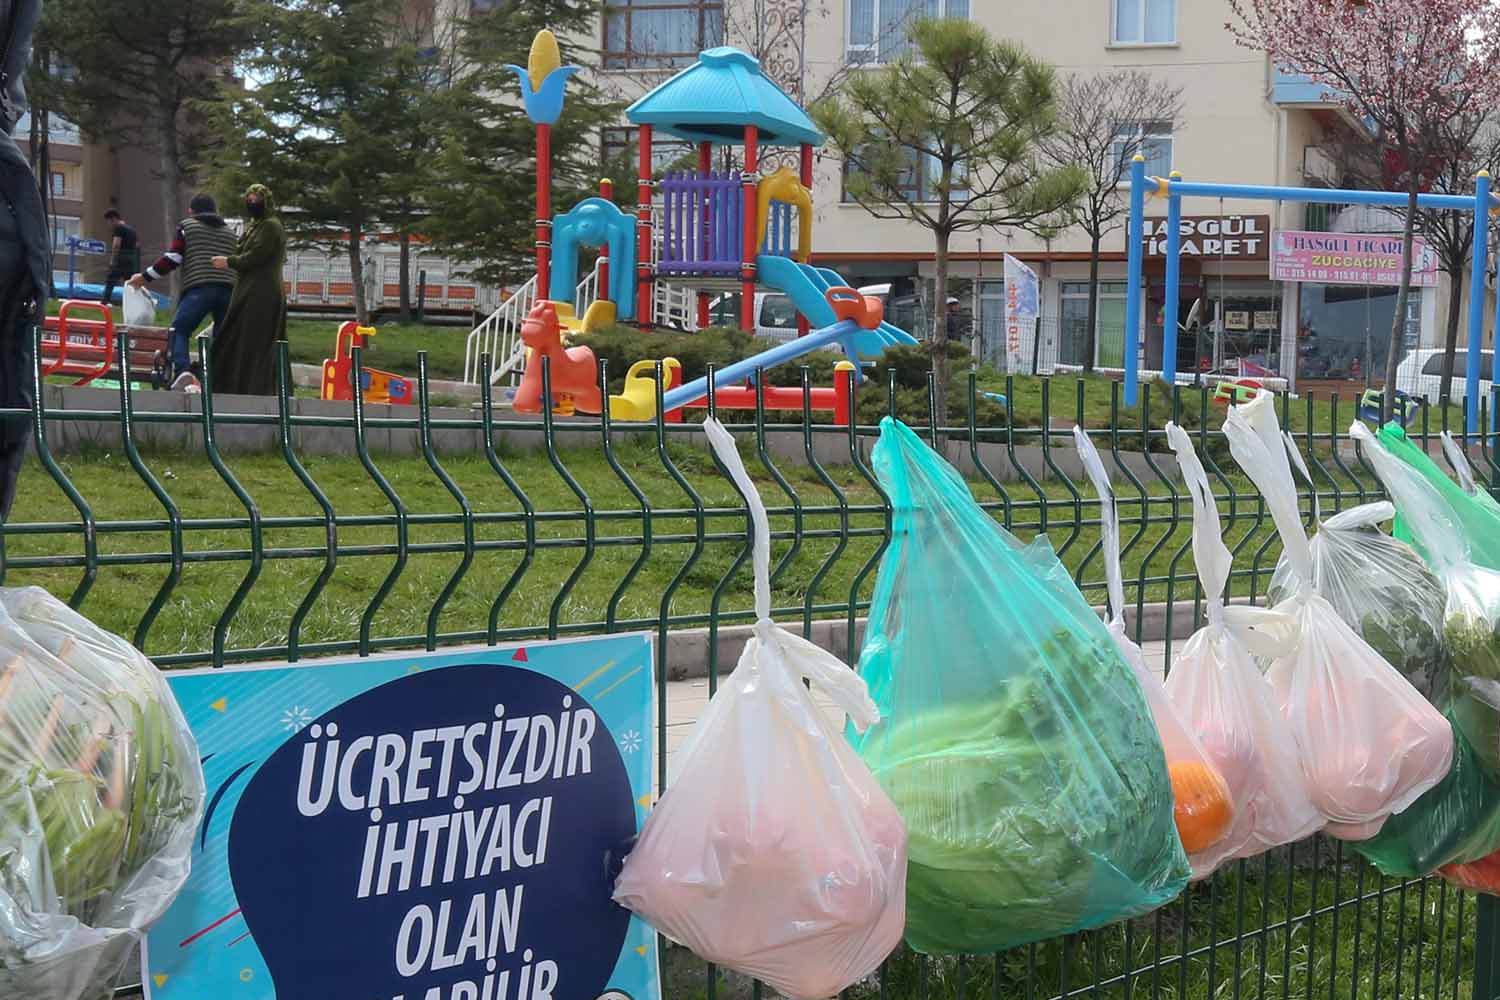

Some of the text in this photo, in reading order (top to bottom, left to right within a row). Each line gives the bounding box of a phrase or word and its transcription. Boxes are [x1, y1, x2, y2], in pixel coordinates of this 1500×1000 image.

[296, 694, 596, 817] ÜCRETSİZDİR
[356, 794, 553, 898] İHTİYACI
[395, 885, 524, 977] OLAN
